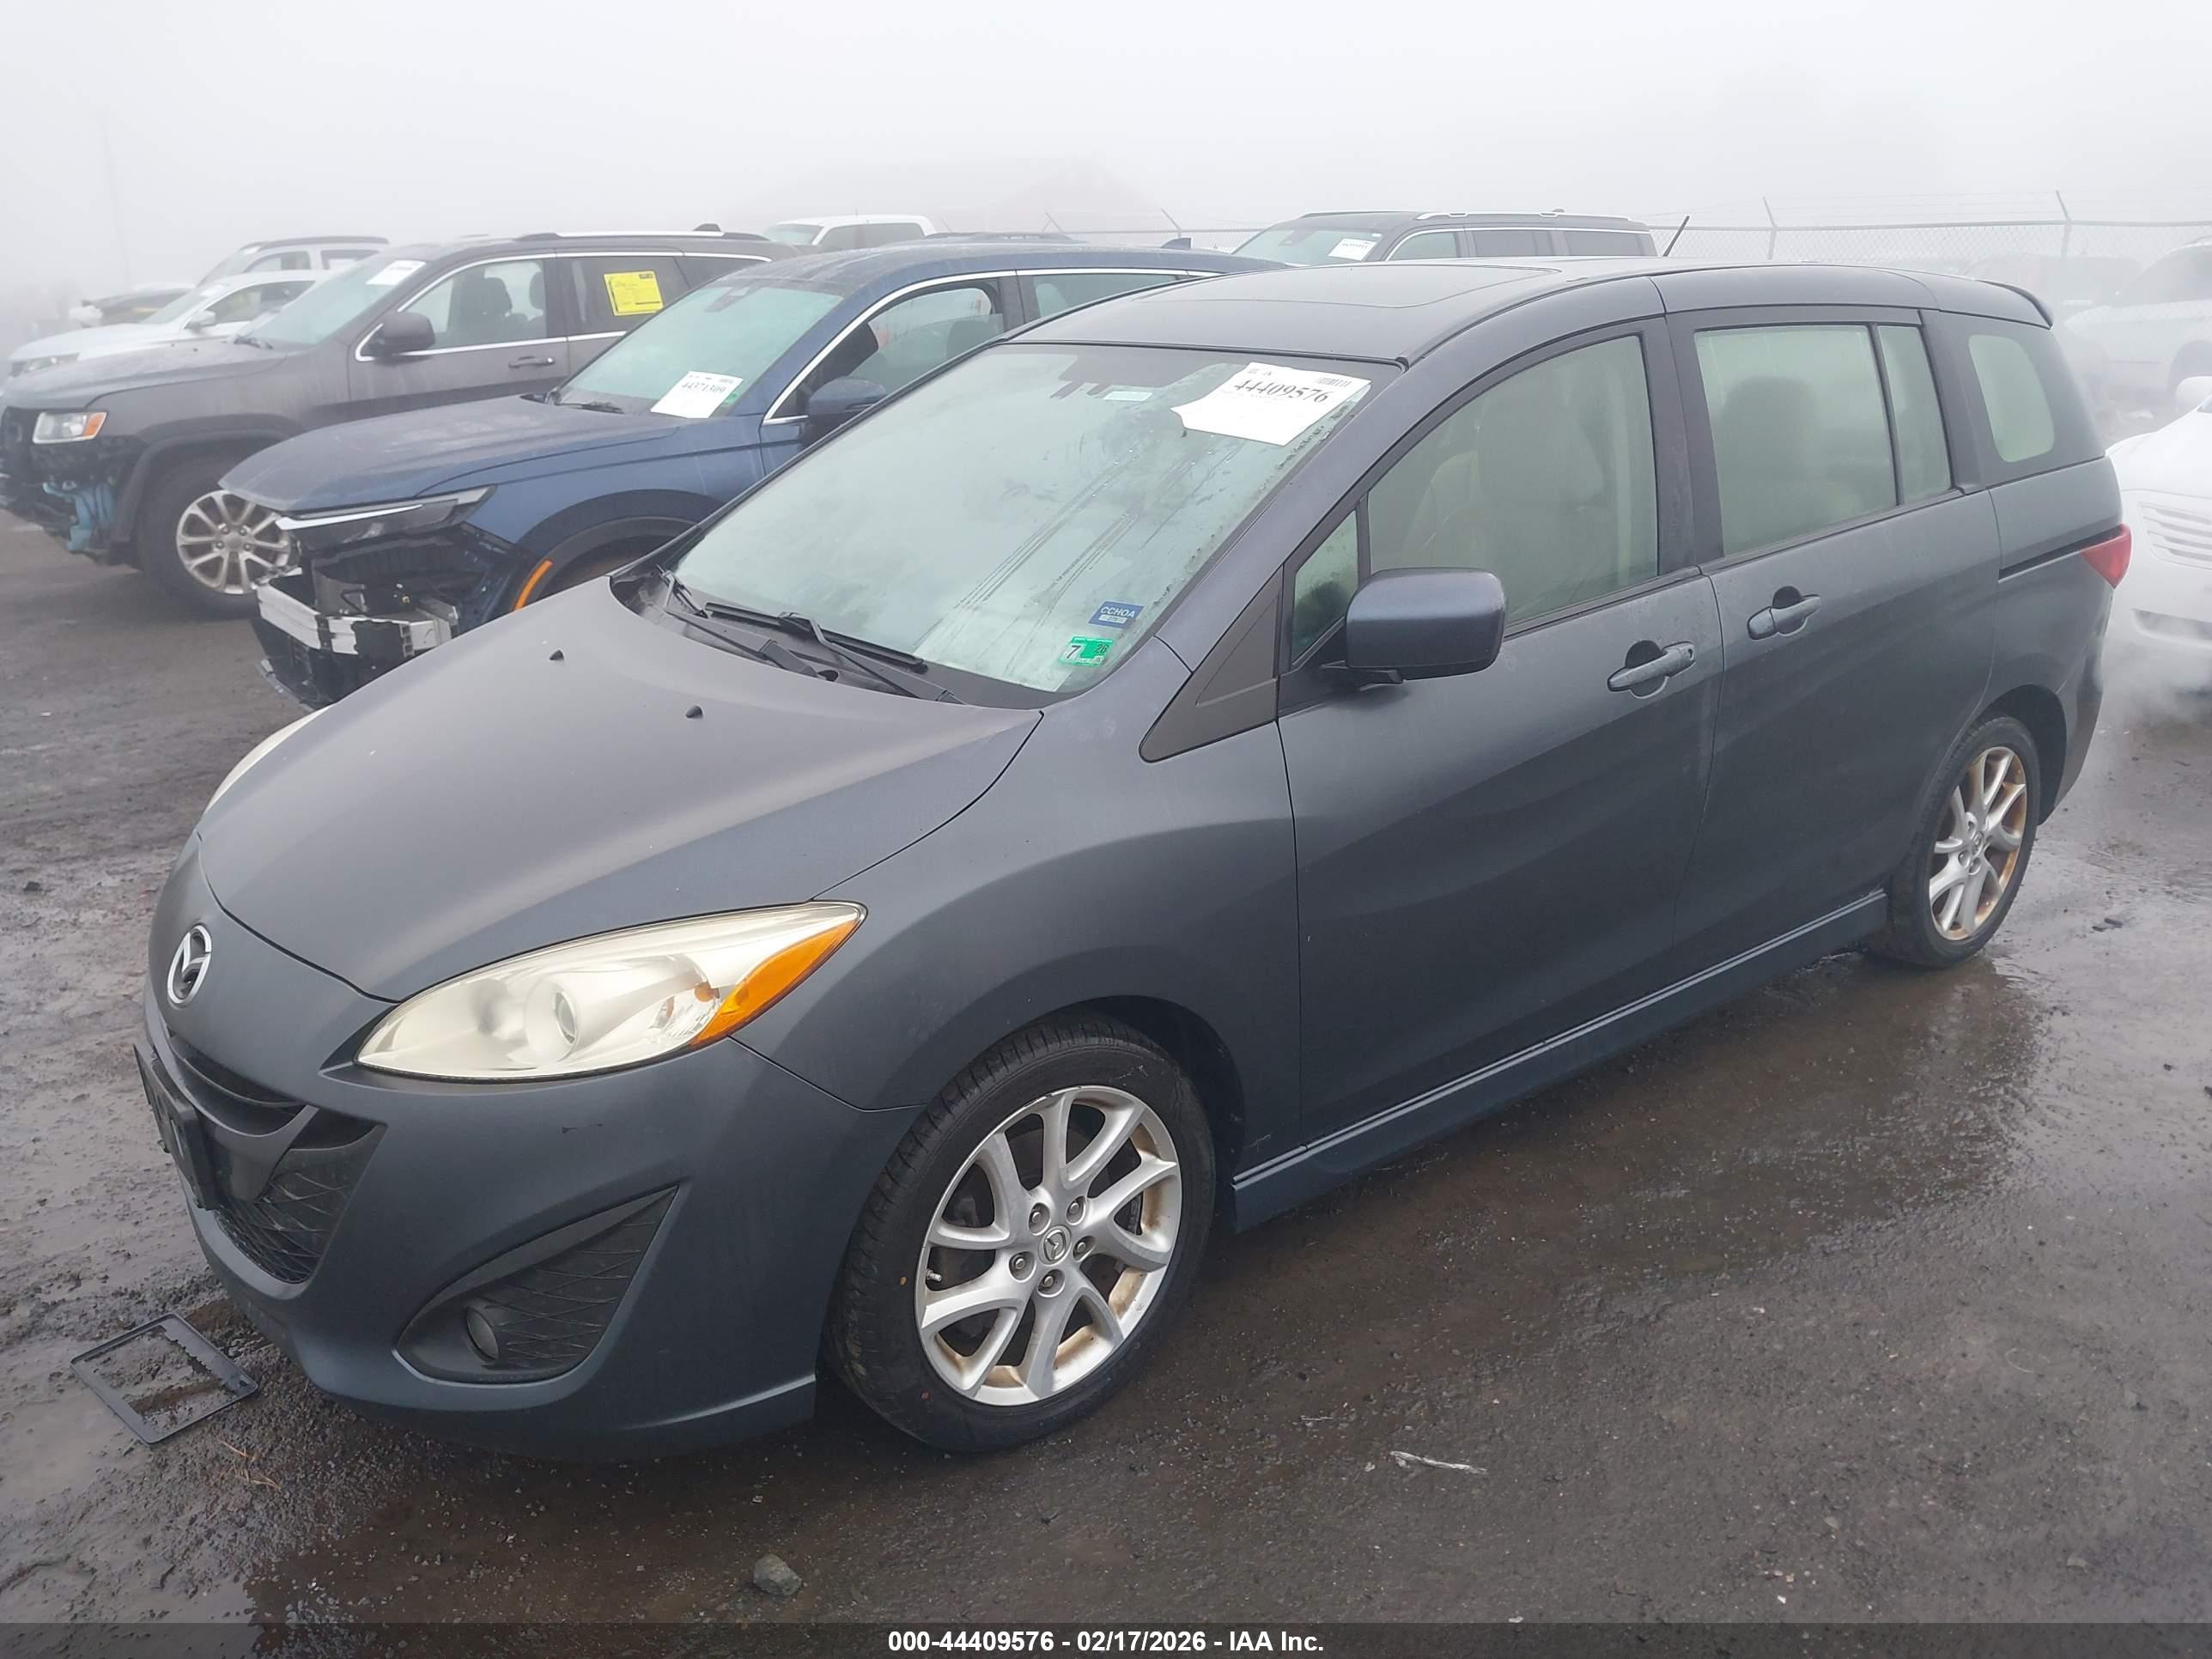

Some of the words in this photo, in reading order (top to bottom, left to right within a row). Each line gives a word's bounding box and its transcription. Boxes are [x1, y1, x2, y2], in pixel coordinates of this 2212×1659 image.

[1234, 379, 1334, 403] 44409576
[1100, 606, 1135, 618] CCHOA
[1066, 645, 1081, 659] 7
